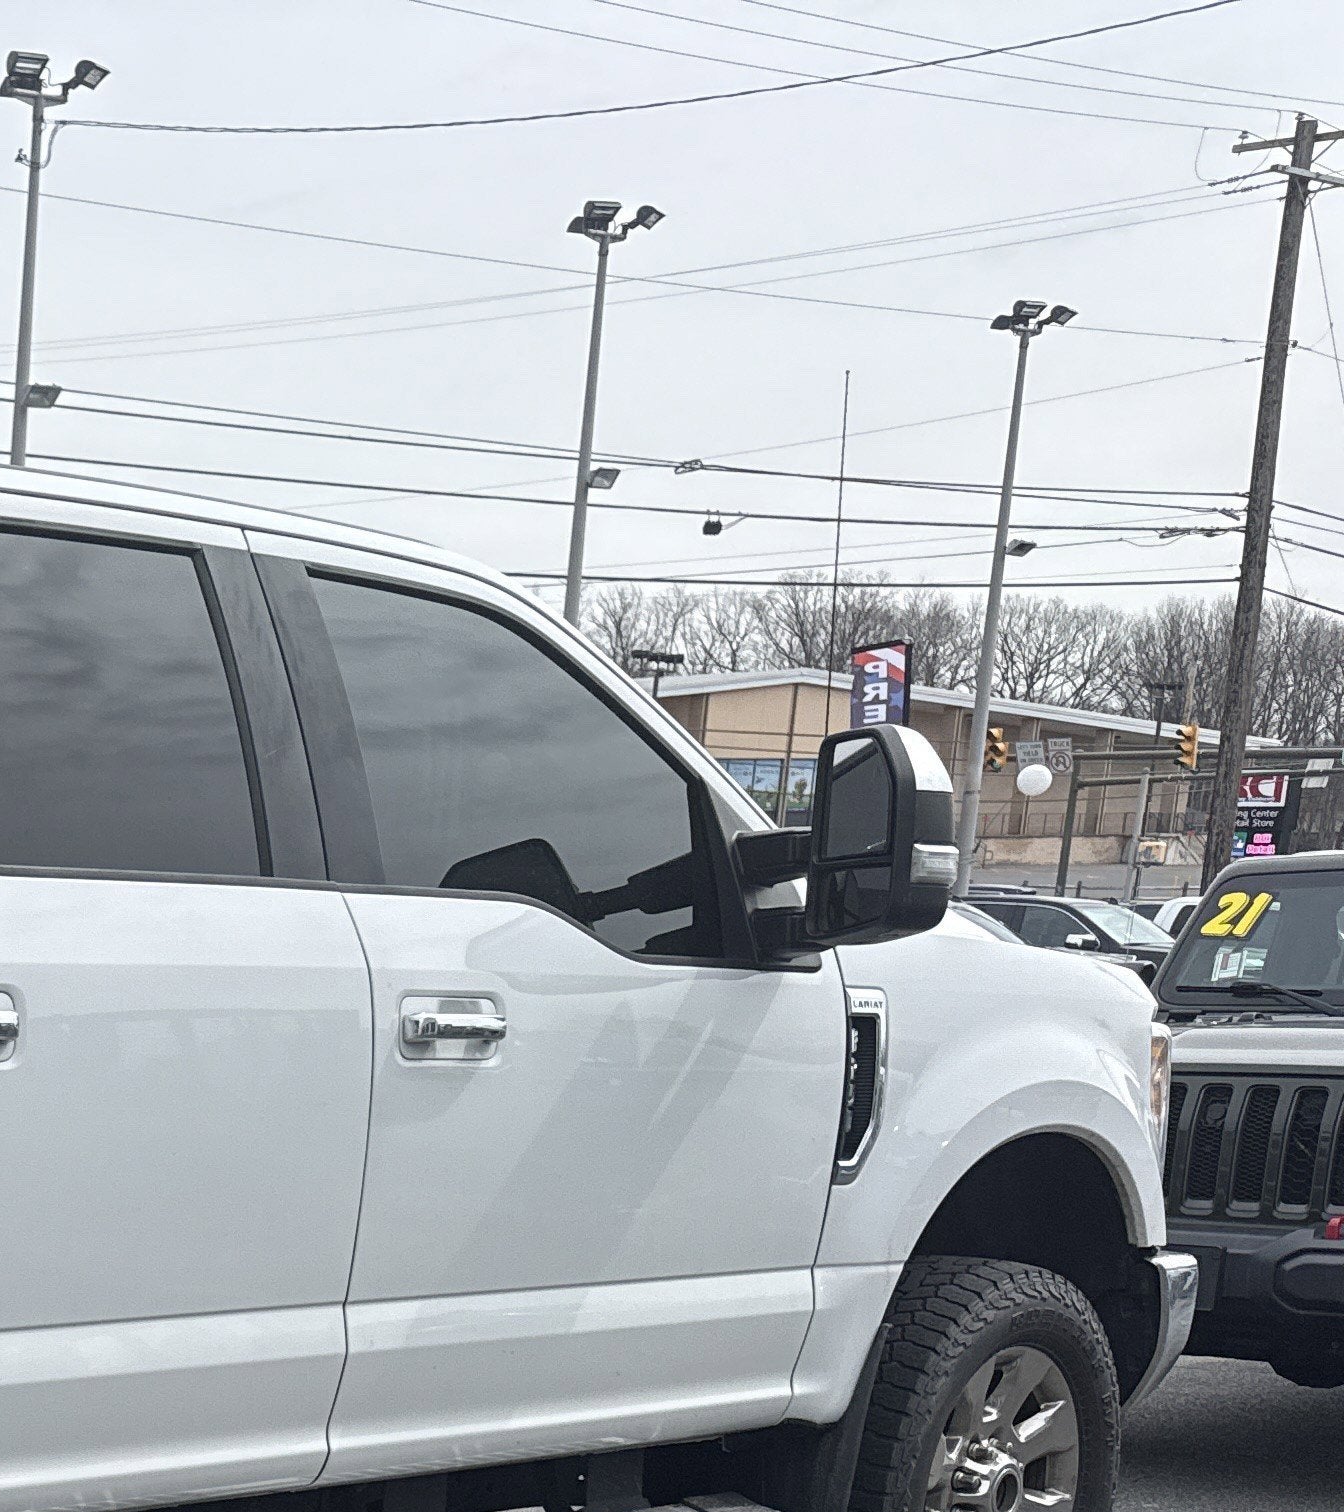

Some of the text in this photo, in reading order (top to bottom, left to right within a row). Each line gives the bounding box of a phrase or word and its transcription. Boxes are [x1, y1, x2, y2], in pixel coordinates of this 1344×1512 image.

[1251, 809, 1279, 818] Center
[1252, 819, 1275, 828] Store
[1200, 891, 1274, 938] 21
[852, 1000, 884, 1009] LARIAT
